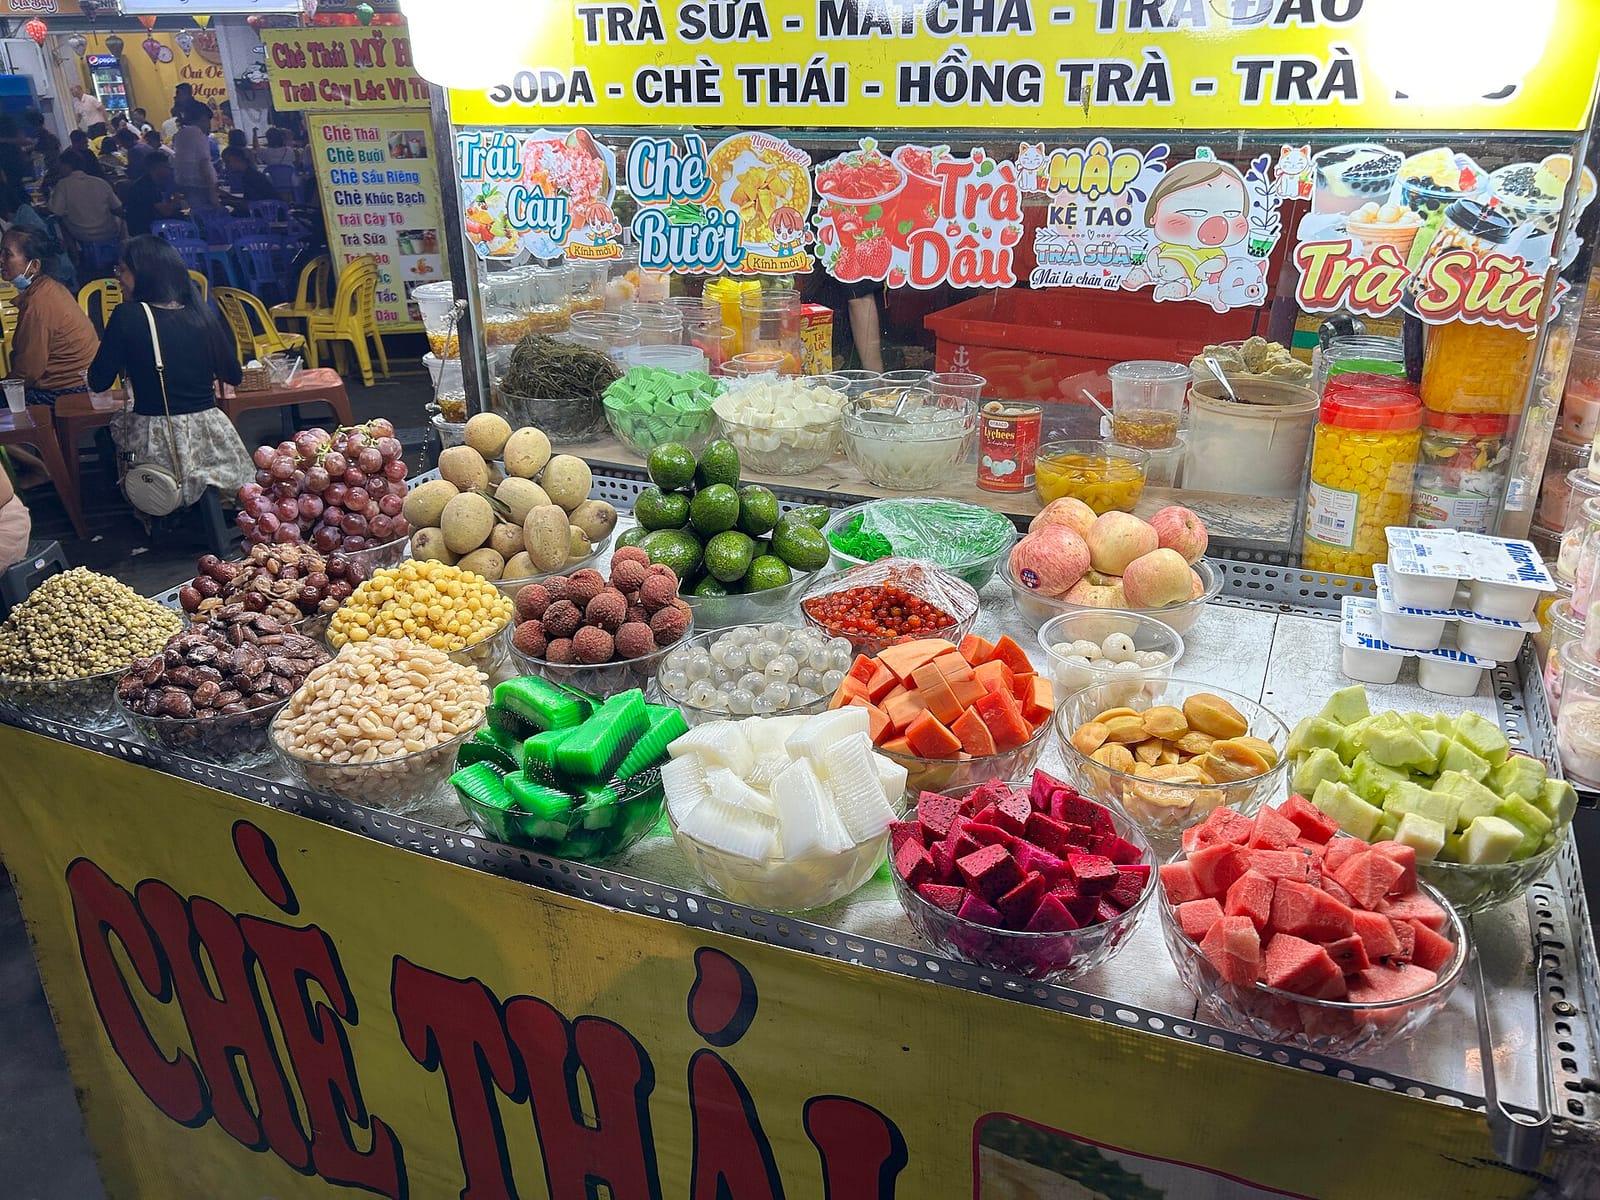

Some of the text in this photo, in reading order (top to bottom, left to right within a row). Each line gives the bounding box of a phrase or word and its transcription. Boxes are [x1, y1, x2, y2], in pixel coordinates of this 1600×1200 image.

[819, 0, 1033, 36] MATCHA
[272, 40, 306, 69] Chè
[307, 40, 348, 69] Thái
[635, 59, 721, 104] CHÈ
[737, 57, 846, 103] THÁI
[899, 47, 1041, 103] HỒNG
[1060, 50, 1172, 102] TRÀ
[1236, 47, 1358, 101] TRÀ
[322, 124, 351, 142] Chè
[751, 134, 779, 151] Ngon
[326, 146, 355, 163] Chè
[456, 131, 523, 181] Trái
[627, 134, 713, 202] Chè
[330, 167, 359, 185] Chè
[1049, 141, 1142, 201] MẬP
[334, 189, 425, 207] Chè Khúc Bạch
[934, 162, 1021, 221] Trà
[507, 184, 572, 245] Cây
[1050, 202, 1132, 229] KỆ TAO
[574, 245, 594, 257] Kính
[632, 208, 747, 271] Bưởi
[1035, 241, 1133, 267] TRÀ SỮA
[752, 257, 778, 269] Kính
[908, 230, 1014, 286] Dâu
[1032, 268, 1061, 286] Mãi
[1062, 269, 1074, 284] là
[1299, 242, 1550, 323] Trà Sữa
[984, 425, 1016, 441] Lychees
[66, 818, 409, 1200] CHÈ
